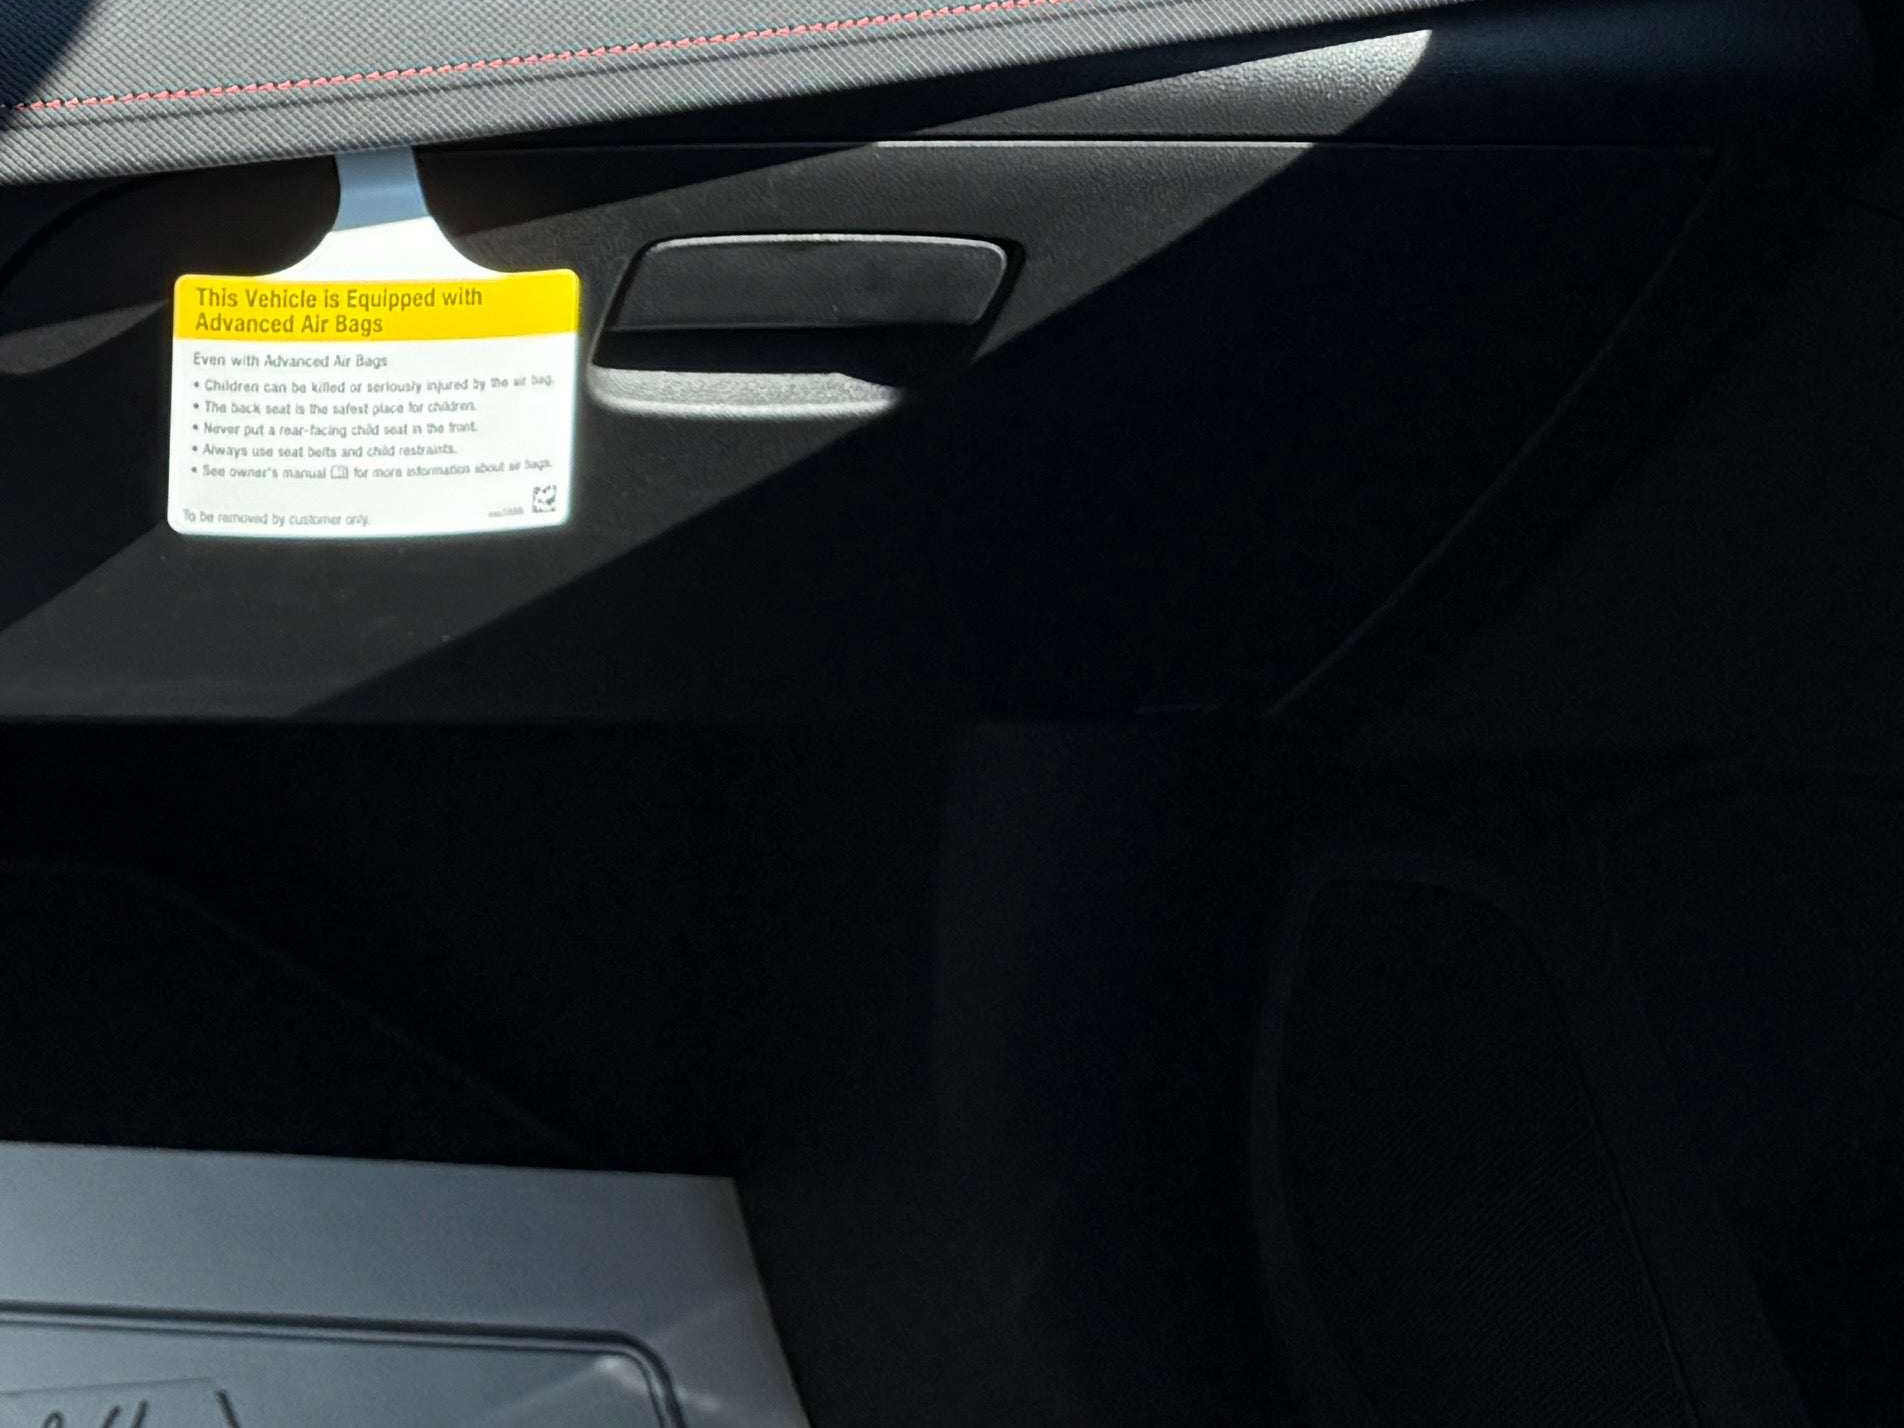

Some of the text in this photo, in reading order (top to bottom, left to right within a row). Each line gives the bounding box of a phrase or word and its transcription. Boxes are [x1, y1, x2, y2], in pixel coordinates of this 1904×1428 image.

[196, 287, 482, 312] This Vehicle is Equipped with
[195, 312, 383, 337] Advanced Air Bags
[193, 352, 389, 370] Even with Advanced Air Bags
[204, 379, 259, 393] Children
[263, 382, 287, 394] can
[291, 381, 307, 394] be
[311, 380, 345, 394] killed
[350, 382, 362, 394] or
[367, 381, 422, 395] seriously
[427, 379, 468, 394] injured
[473, 377, 486, 391] by
[490, 376, 509, 388] the
[513, 375, 527, 387] air
[205, 400, 227, 414] The
[231, 402, 261, 414] back
[265, 403, 291, 415] seat
[295, 403, 305, 415] is
[309, 403, 328, 415] the
[333, 403, 368, 415] safest
[372, 404, 404, 416] place
[408, 402, 423, 413] for
[203, 421, 240, 435] Never
[244, 424, 265, 437] put
[268, 426, 276, 436] a
[279, 423, 347, 438] rear-facing
[351, 423, 379, 436] child
[384, 424, 408, 435] seat
[412, 423, 422, 435] in
[426, 422, 444, 434] the
[203, 442, 248, 459] Always
[252, 447, 274, 457] use
[278, 446, 303, 458] seat
[308, 445, 337, 458] belts
[341, 445, 363, 457] and
[367, 444, 395, 457] child
[202, 464, 225, 477] See
[229, 466, 278, 478] owner's
[282, 466, 327, 479] manual
[353, 466, 368, 478] for
[372, 467, 402, 478] more
[406, 463, 470, 477] information
[474, 460, 505, 473] about
[182, 508, 196, 523] To
[200, 509, 214, 523] be
[218, 511, 267, 525] removed
[271, 512, 285, 527] by
[289, 513, 342, 526] customer
